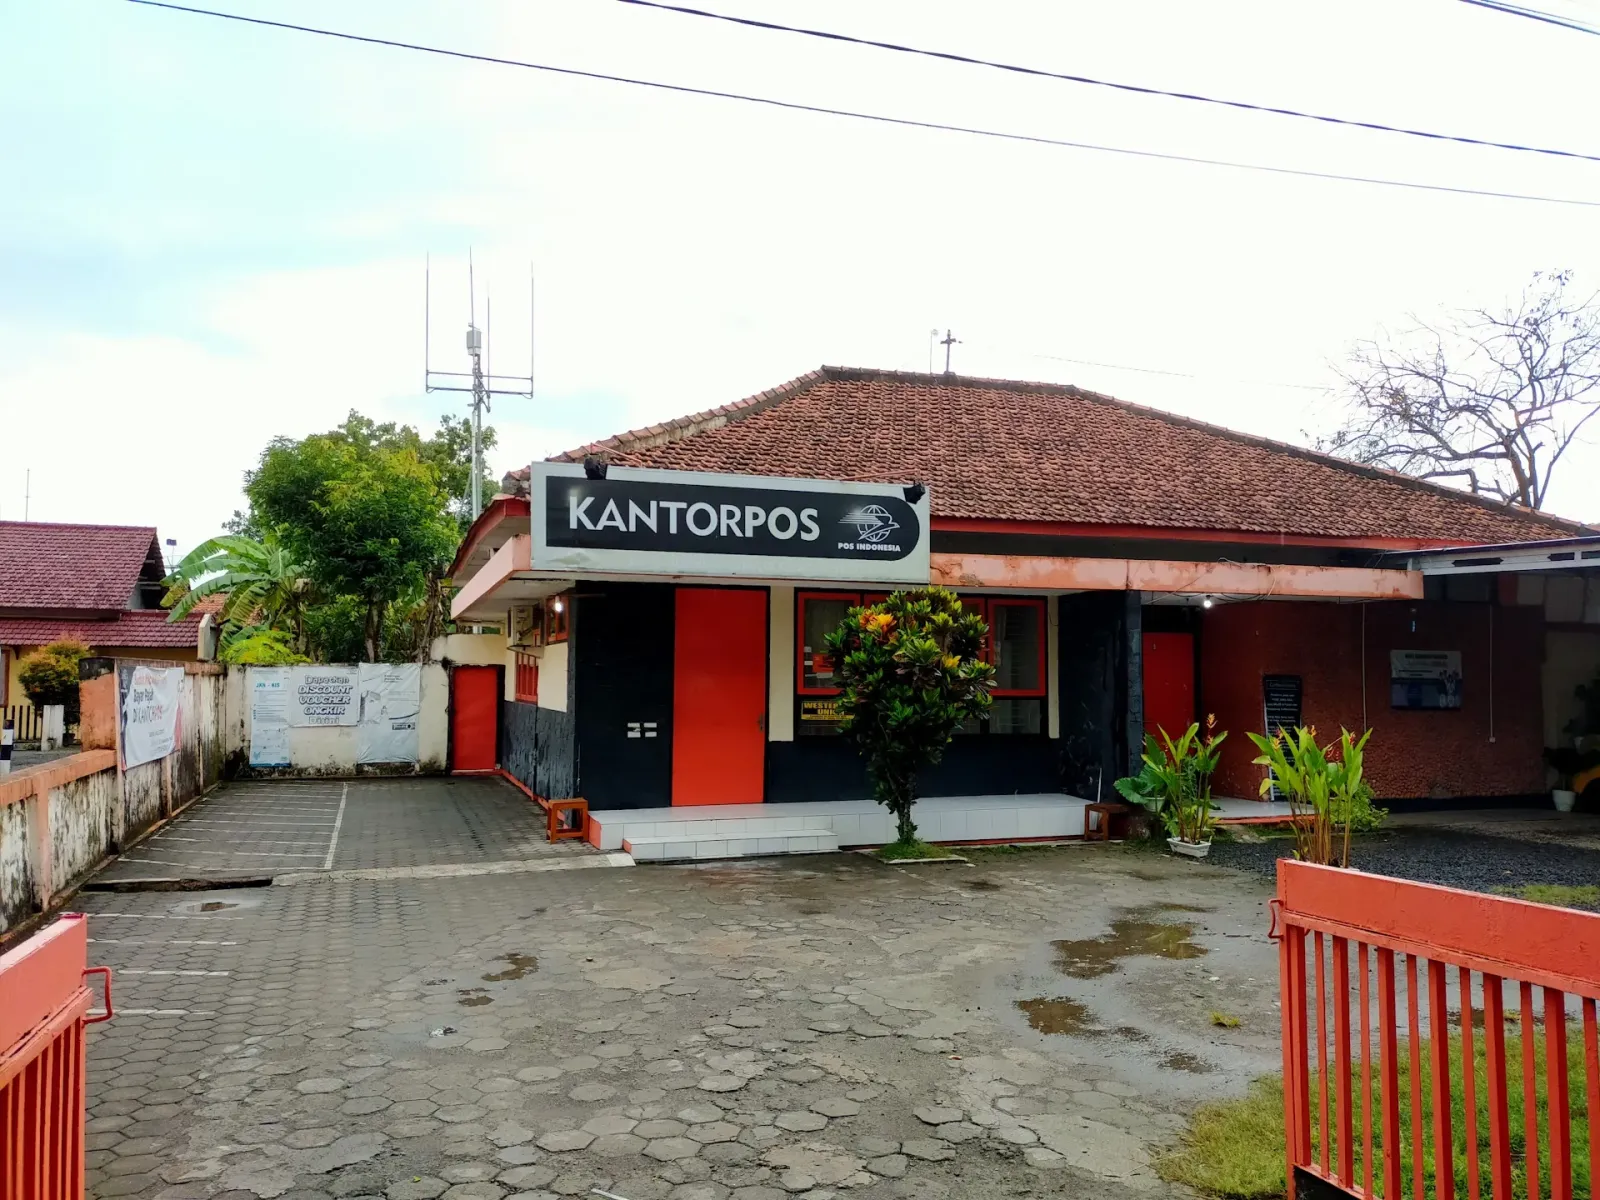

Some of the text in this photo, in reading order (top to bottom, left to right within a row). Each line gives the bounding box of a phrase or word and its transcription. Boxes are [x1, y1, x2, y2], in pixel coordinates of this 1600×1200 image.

[568, 495, 820, 542] KANTORPOS
[837, 542, 901, 552] POS INDONESIA
[298, 685, 353, 695] DISCOUNT
[299, 695, 351, 705] VOUCHER
[303, 705, 346, 715] ONGKIR
